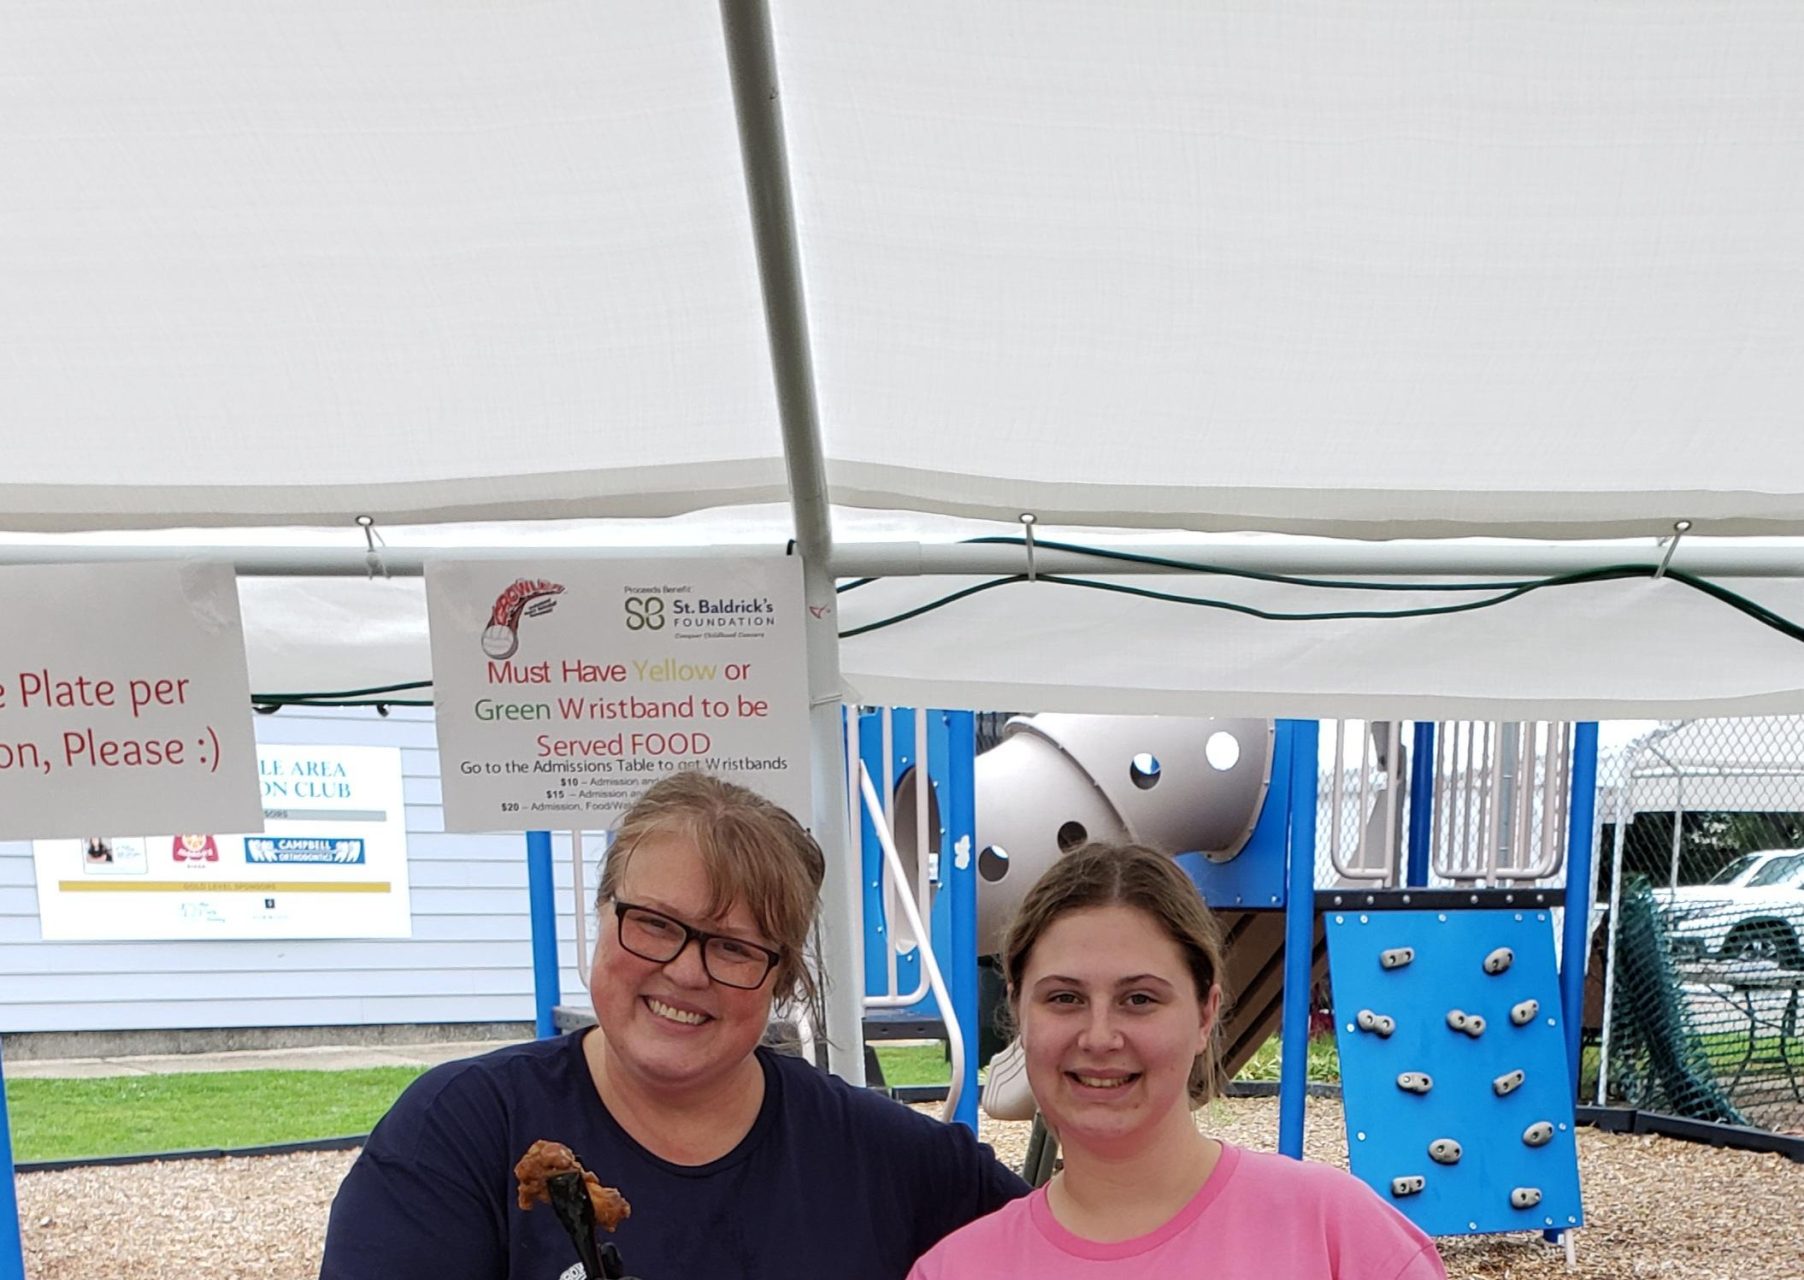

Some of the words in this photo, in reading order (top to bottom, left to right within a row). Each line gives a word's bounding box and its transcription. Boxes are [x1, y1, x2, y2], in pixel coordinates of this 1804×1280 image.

[673, 599, 696, 614] St.
[699, 598, 774, 614] Baldrick's
[674, 616, 775, 627] FOUNDATION
[488, 660, 552, 684] Must
[562, 659, 627, 683] Have
[632, 657, 718, 683] Yellow
[724, 662, 752, 681] or
[19, 669, 115, 708] Plate
[129, 678, 190, 718] per
[475, 698, 551, 721] Green
[558, 695, 695, 719] Wristband
[702, 698, 730, 718] to
[738, 694, 768, 718] be
[63, 728, 185, 767] Please
[198, 726, 220, 773] :)
[537, 732, 624, 757] Served
[631, 732, 711, 756] FOOD
[292, 761, 347, 777] AREA
[460, 760, 482, 775] Go
[485, 761, 502, 774] to
[505, 759, 530, 774] the
[532, 758, 613, 774] Admissions
[616, 757, 655, 772] Table
[658, 759, 674, 771] to
[705, 756, 788, 770] Wristbands
[295, 782, 352, 799] CLUB
[560, 777, 579, 787] $10
[590, 777, 640, 786] Admission
[545, 789, 565, 799] $15
[579, 789, 628, 799] Admission
[501, 802, 520, 812] $20
